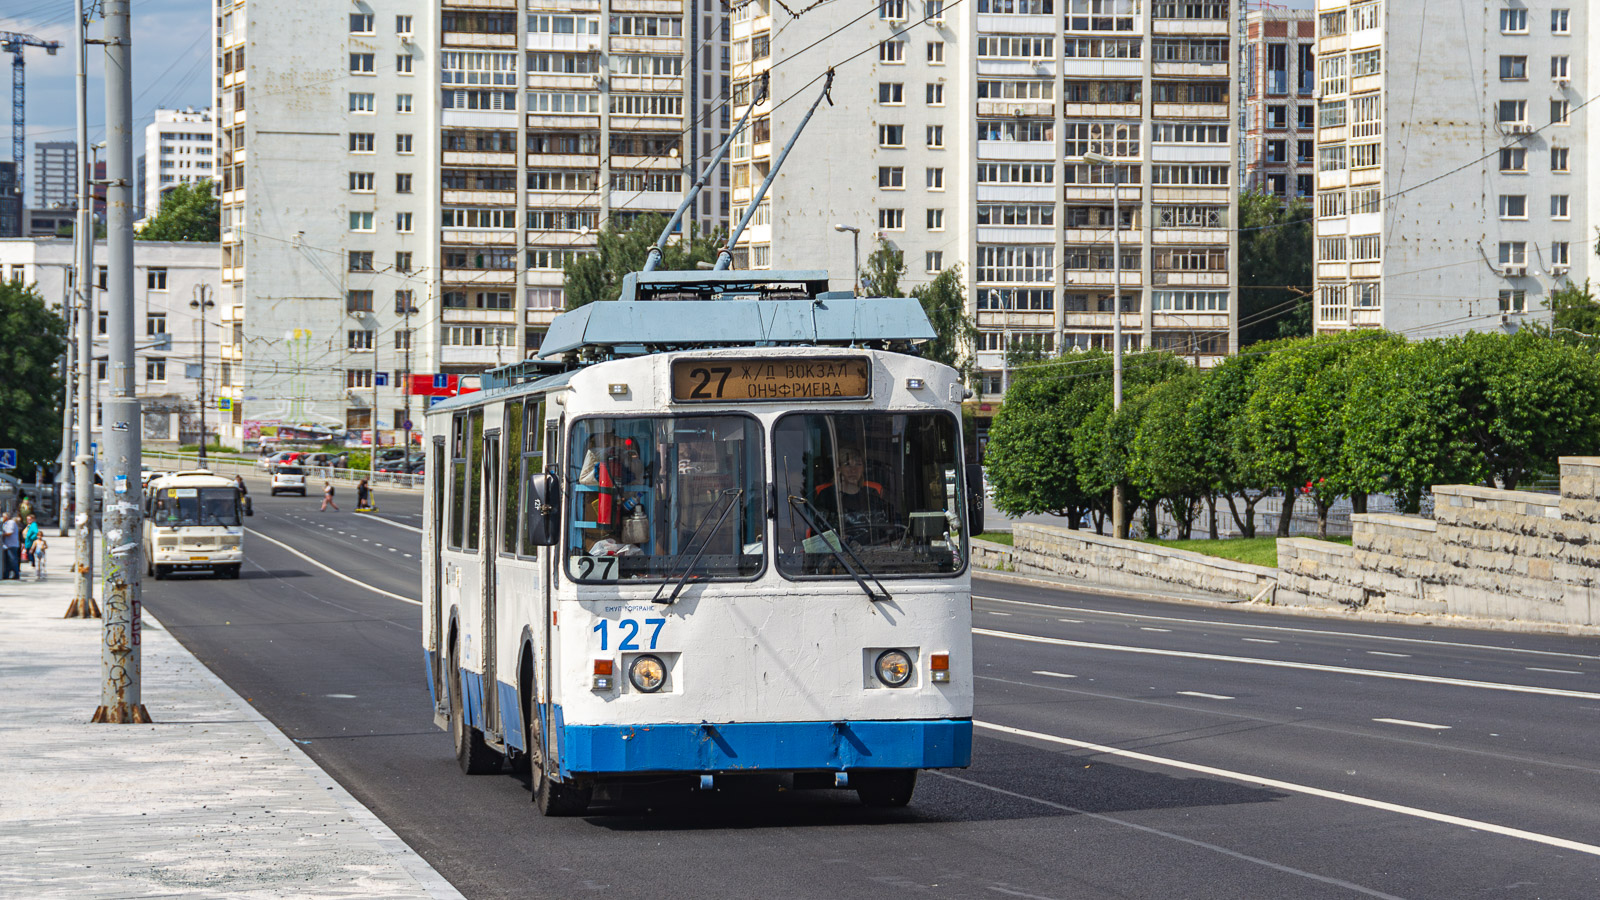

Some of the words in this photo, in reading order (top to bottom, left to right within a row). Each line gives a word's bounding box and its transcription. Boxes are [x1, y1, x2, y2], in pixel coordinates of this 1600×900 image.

[689, 366, 732, 399] 27
[741, 364, 776, 380] Ж/Д
[786, 363, 848, 379] ВОКЗАЛ
[748, 382, 843, 398] ОНУФРИЕВА
[577, 557, 616, 580] 27
[593, 618, 666, 651] 127
